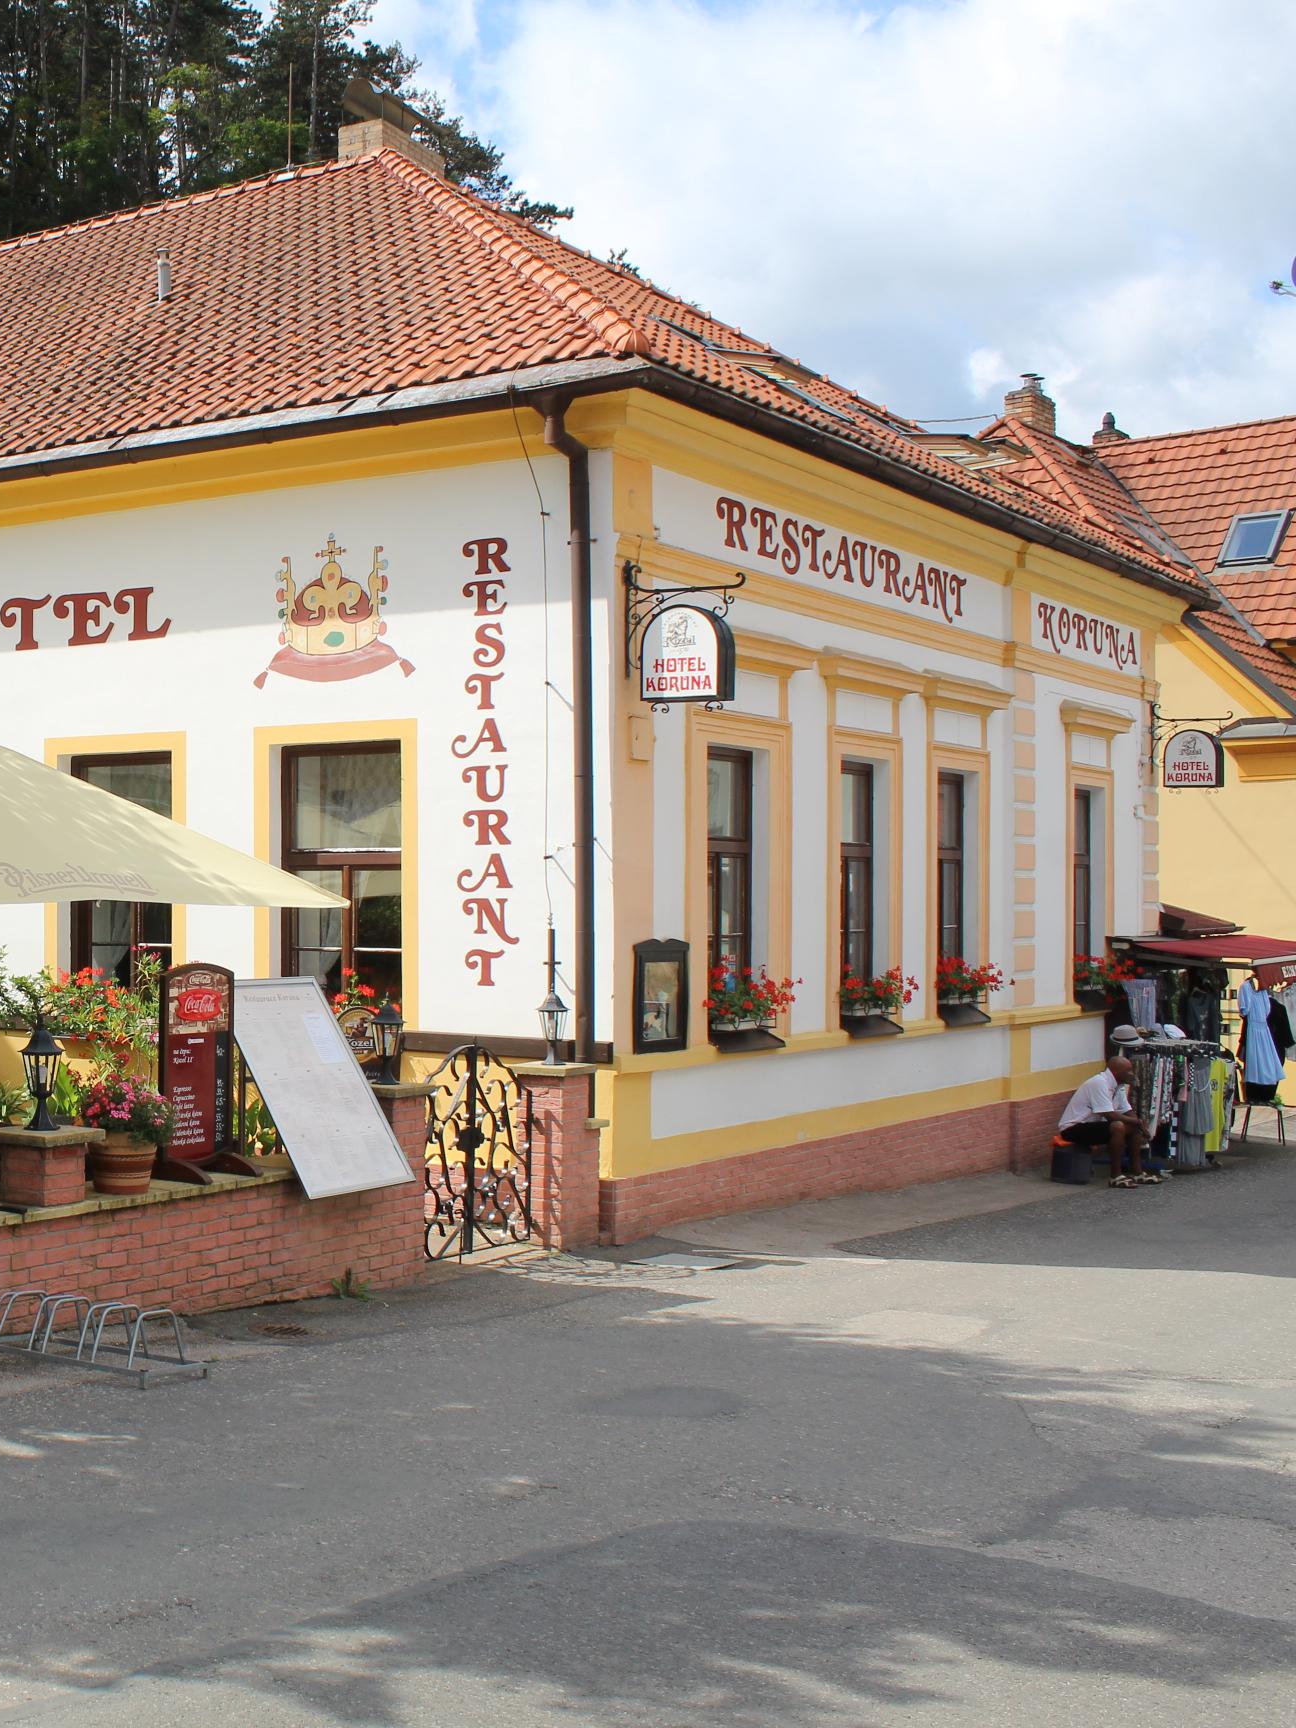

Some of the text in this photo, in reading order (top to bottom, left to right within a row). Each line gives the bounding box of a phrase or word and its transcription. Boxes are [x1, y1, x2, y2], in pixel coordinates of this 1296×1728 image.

[716, 497, 966, 623] RESTAURANT
[1038, 602, 1137, 671] KORUNA
[653, 657, 706, 673] HOTEL
[646, 675, 712, 692] KORUNA
[451, 537, 520, 986] RESTAURANT
[1173, 761, 1209, 771] HOTEL
[1167, 773, 1213, 783] KORUNA
[65, 863, 153, 894] Urquell
[184, 994, 216, 1014] Coca-Cola
